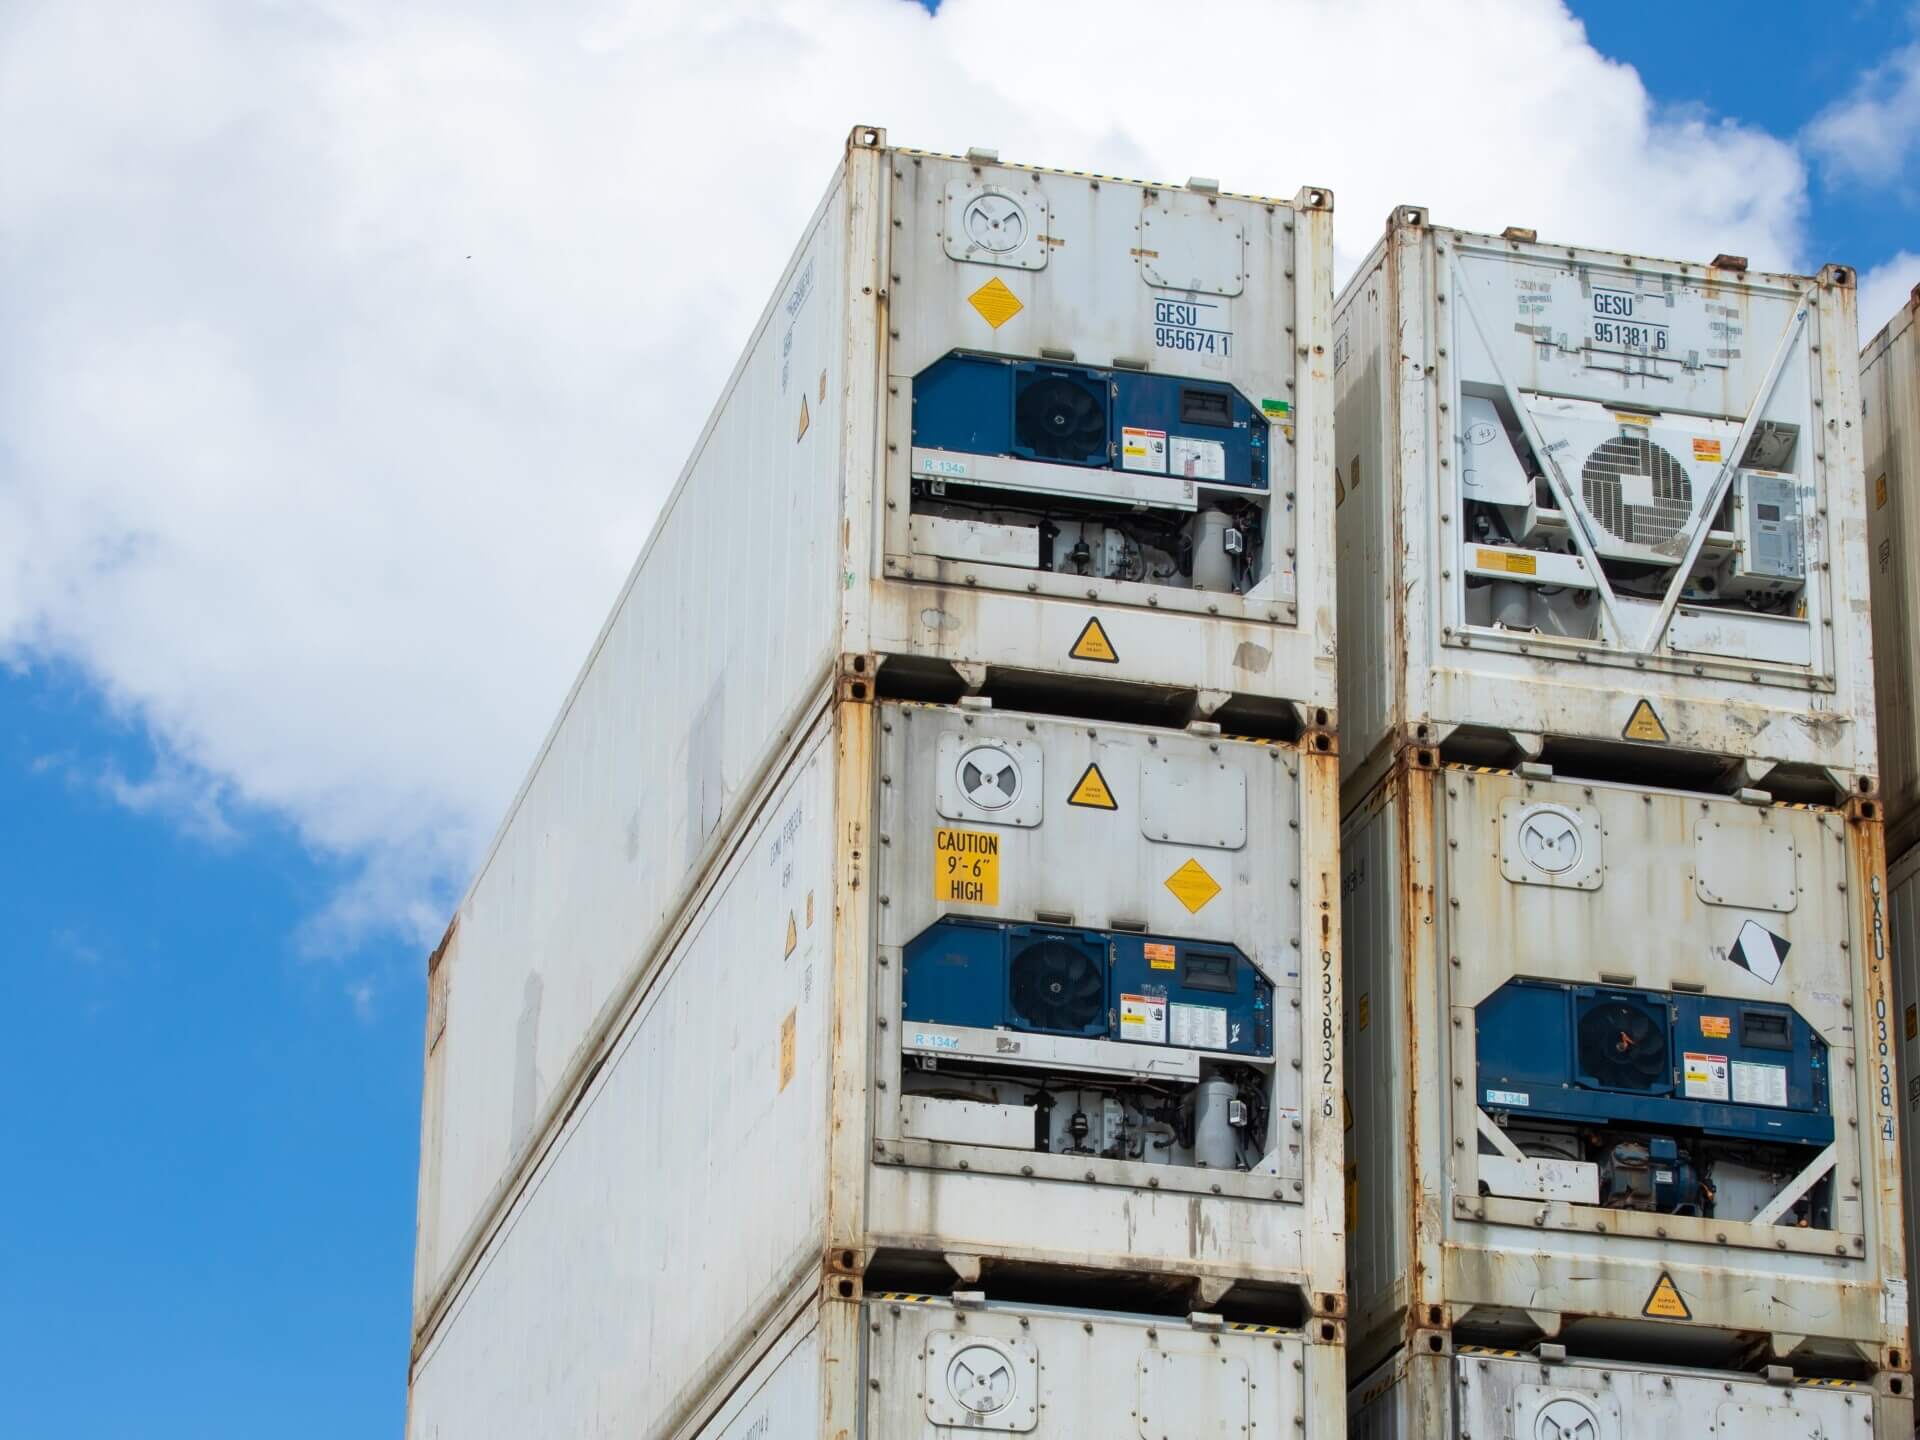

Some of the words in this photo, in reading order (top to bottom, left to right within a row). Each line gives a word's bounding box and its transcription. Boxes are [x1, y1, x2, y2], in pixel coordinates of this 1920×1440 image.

[1156, 302, 1197, 326] GESU
[1594, 293, 1633, 316] GESU
[1155, 327, 1215, 354] 955674
[1222, 336, 1228, 356] 1
[1594, 322, 1649, 346] 951381
[1656, 330, 1666, 350] 6
[937, 831, 998, 856] CAUTION
[951, 879, 983, 902] HIGH
[1321, 951, 1333, 1084] 933832
